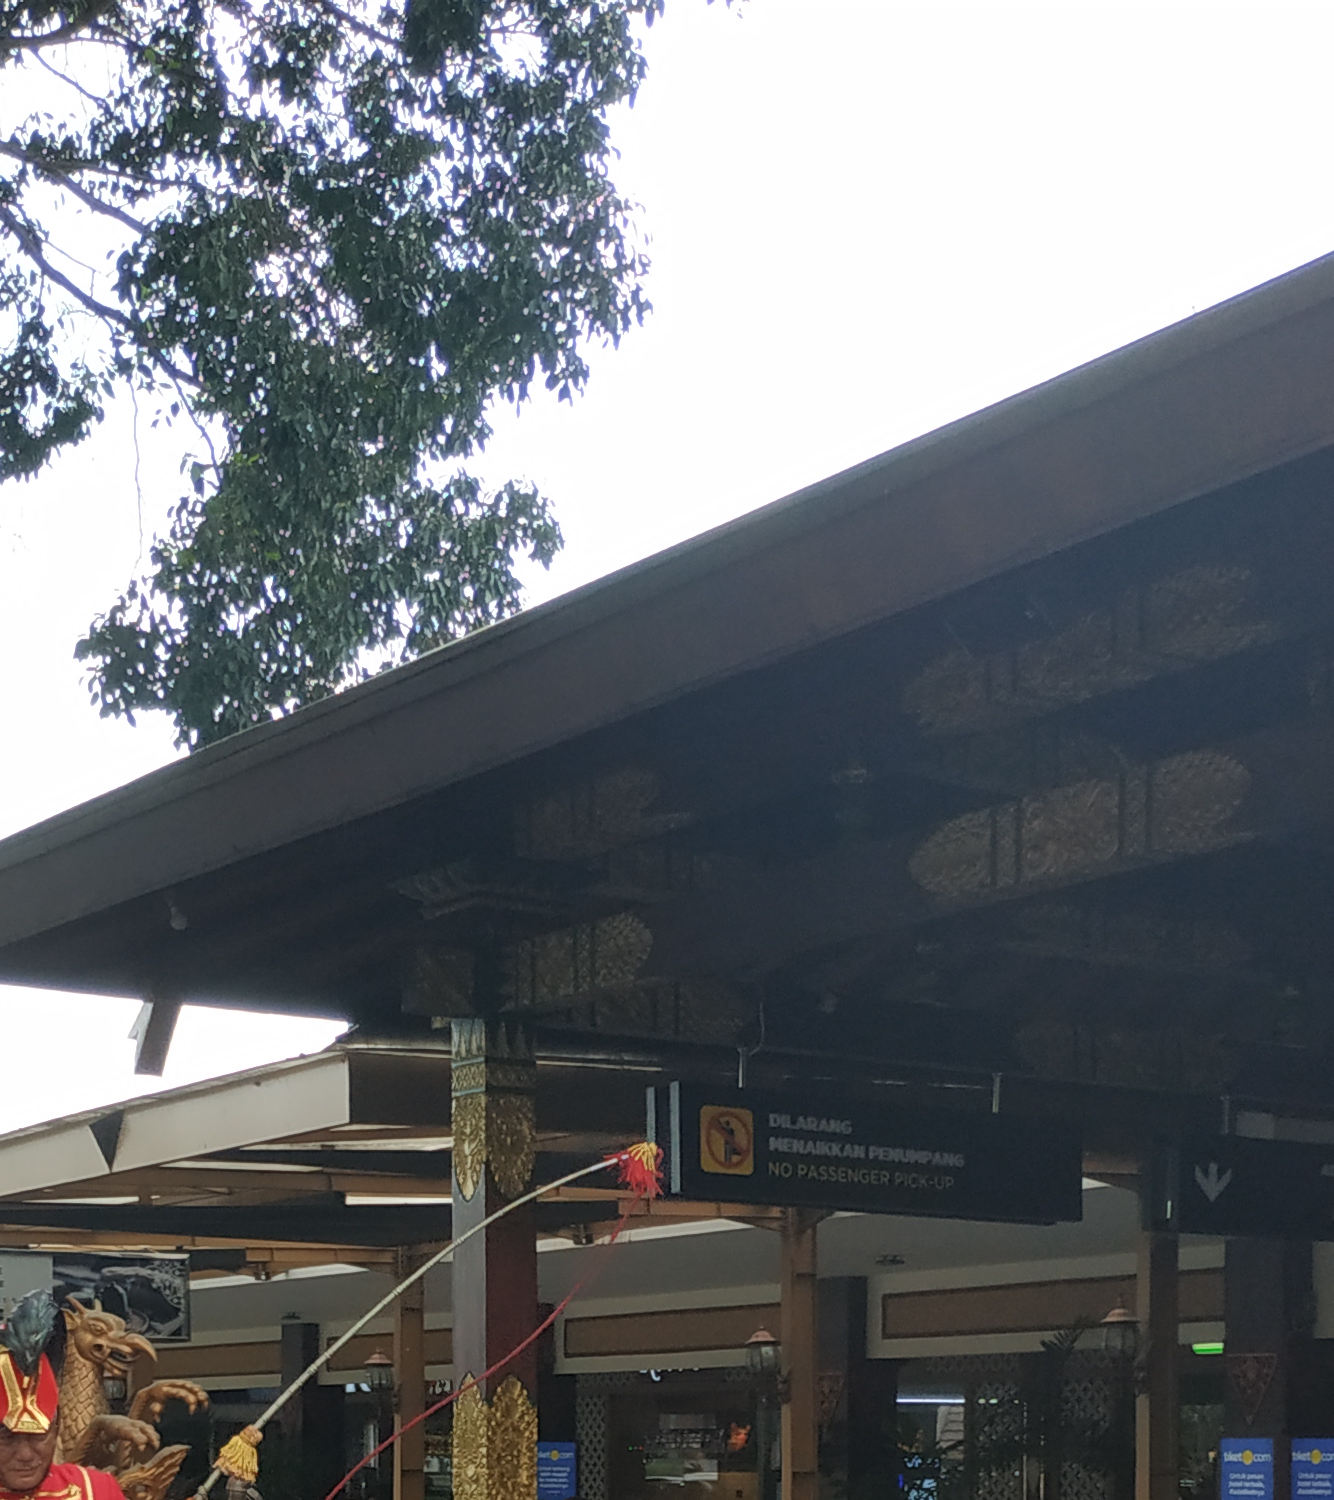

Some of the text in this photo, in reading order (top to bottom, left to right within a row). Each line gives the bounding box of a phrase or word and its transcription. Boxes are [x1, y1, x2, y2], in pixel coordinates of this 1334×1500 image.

[768, 1113, 853, 1135] DILARANG
[768, 1136, 866, 1159] MENAIKKAN
[768, 1161, 956, 1190] NO PASSENGER PICK-UP
